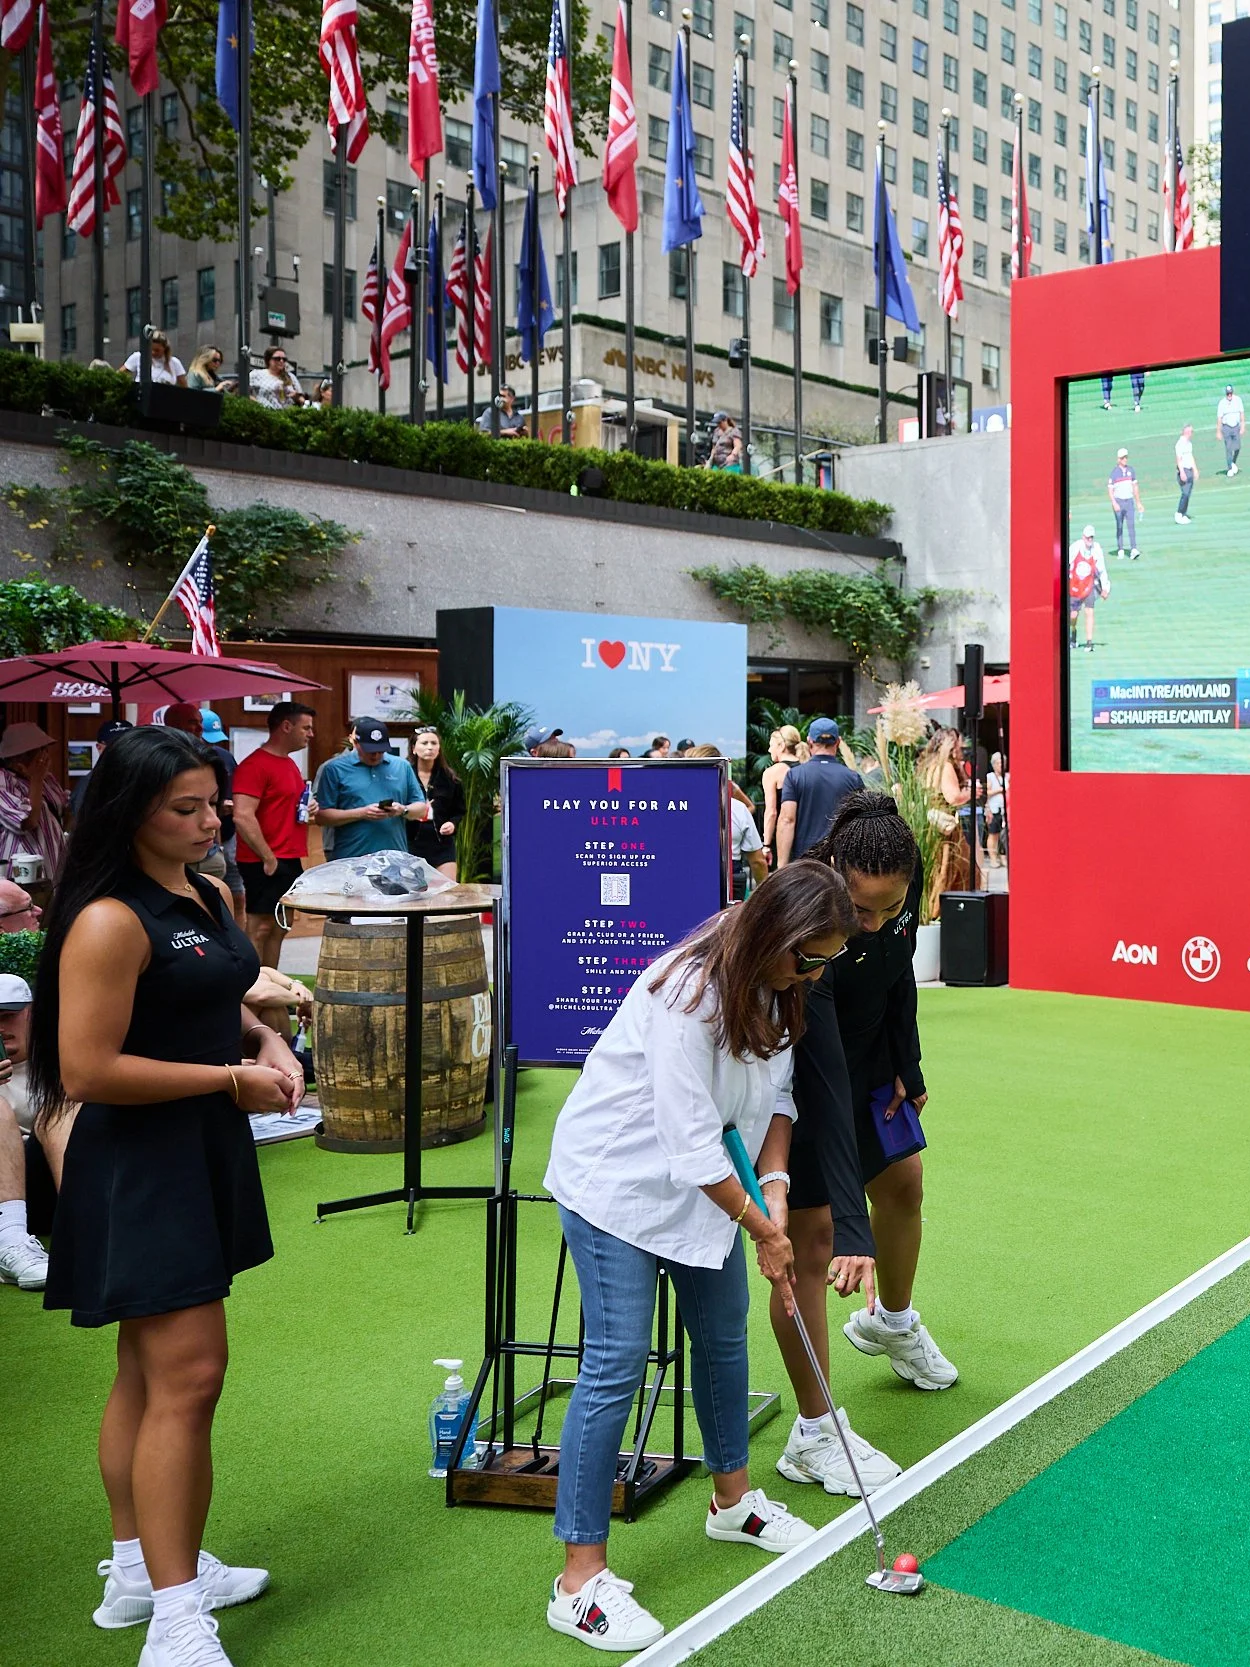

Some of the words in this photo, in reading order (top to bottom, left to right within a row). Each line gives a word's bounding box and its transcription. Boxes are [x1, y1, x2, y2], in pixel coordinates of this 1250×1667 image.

[634, 355, 667, 379] NBC
[581, 638, 596, 668] I
[627, 641, 681, 672] NY
[1109, 683, 1231, 699] MacINTYRE/HOVLAND
[1110, 709, 1231, 724] SCHAUFFELE/CANTLAY
[543, 800, 580, 810] PLAY
[590, 800, 620, 810] YOU
[629, 800, 658, 810] FOR
[668, 800, 688, 810] AN
[591, 816, 639, 826] ULTRA
[585, 842, 615, 850] STEP
[621, 842, 645, 850] ONE
[584, 920, 614, 928] STEP
[620, 920, 646, 928] TWO
[894, 912, 912, 934] ULTRA
[171, 935, 209, 949] ULTRA
[1112, 940, 1158, 965] AON
[578, 957, 608, 965] STEP
[582, 986, 611, 994] STEP
